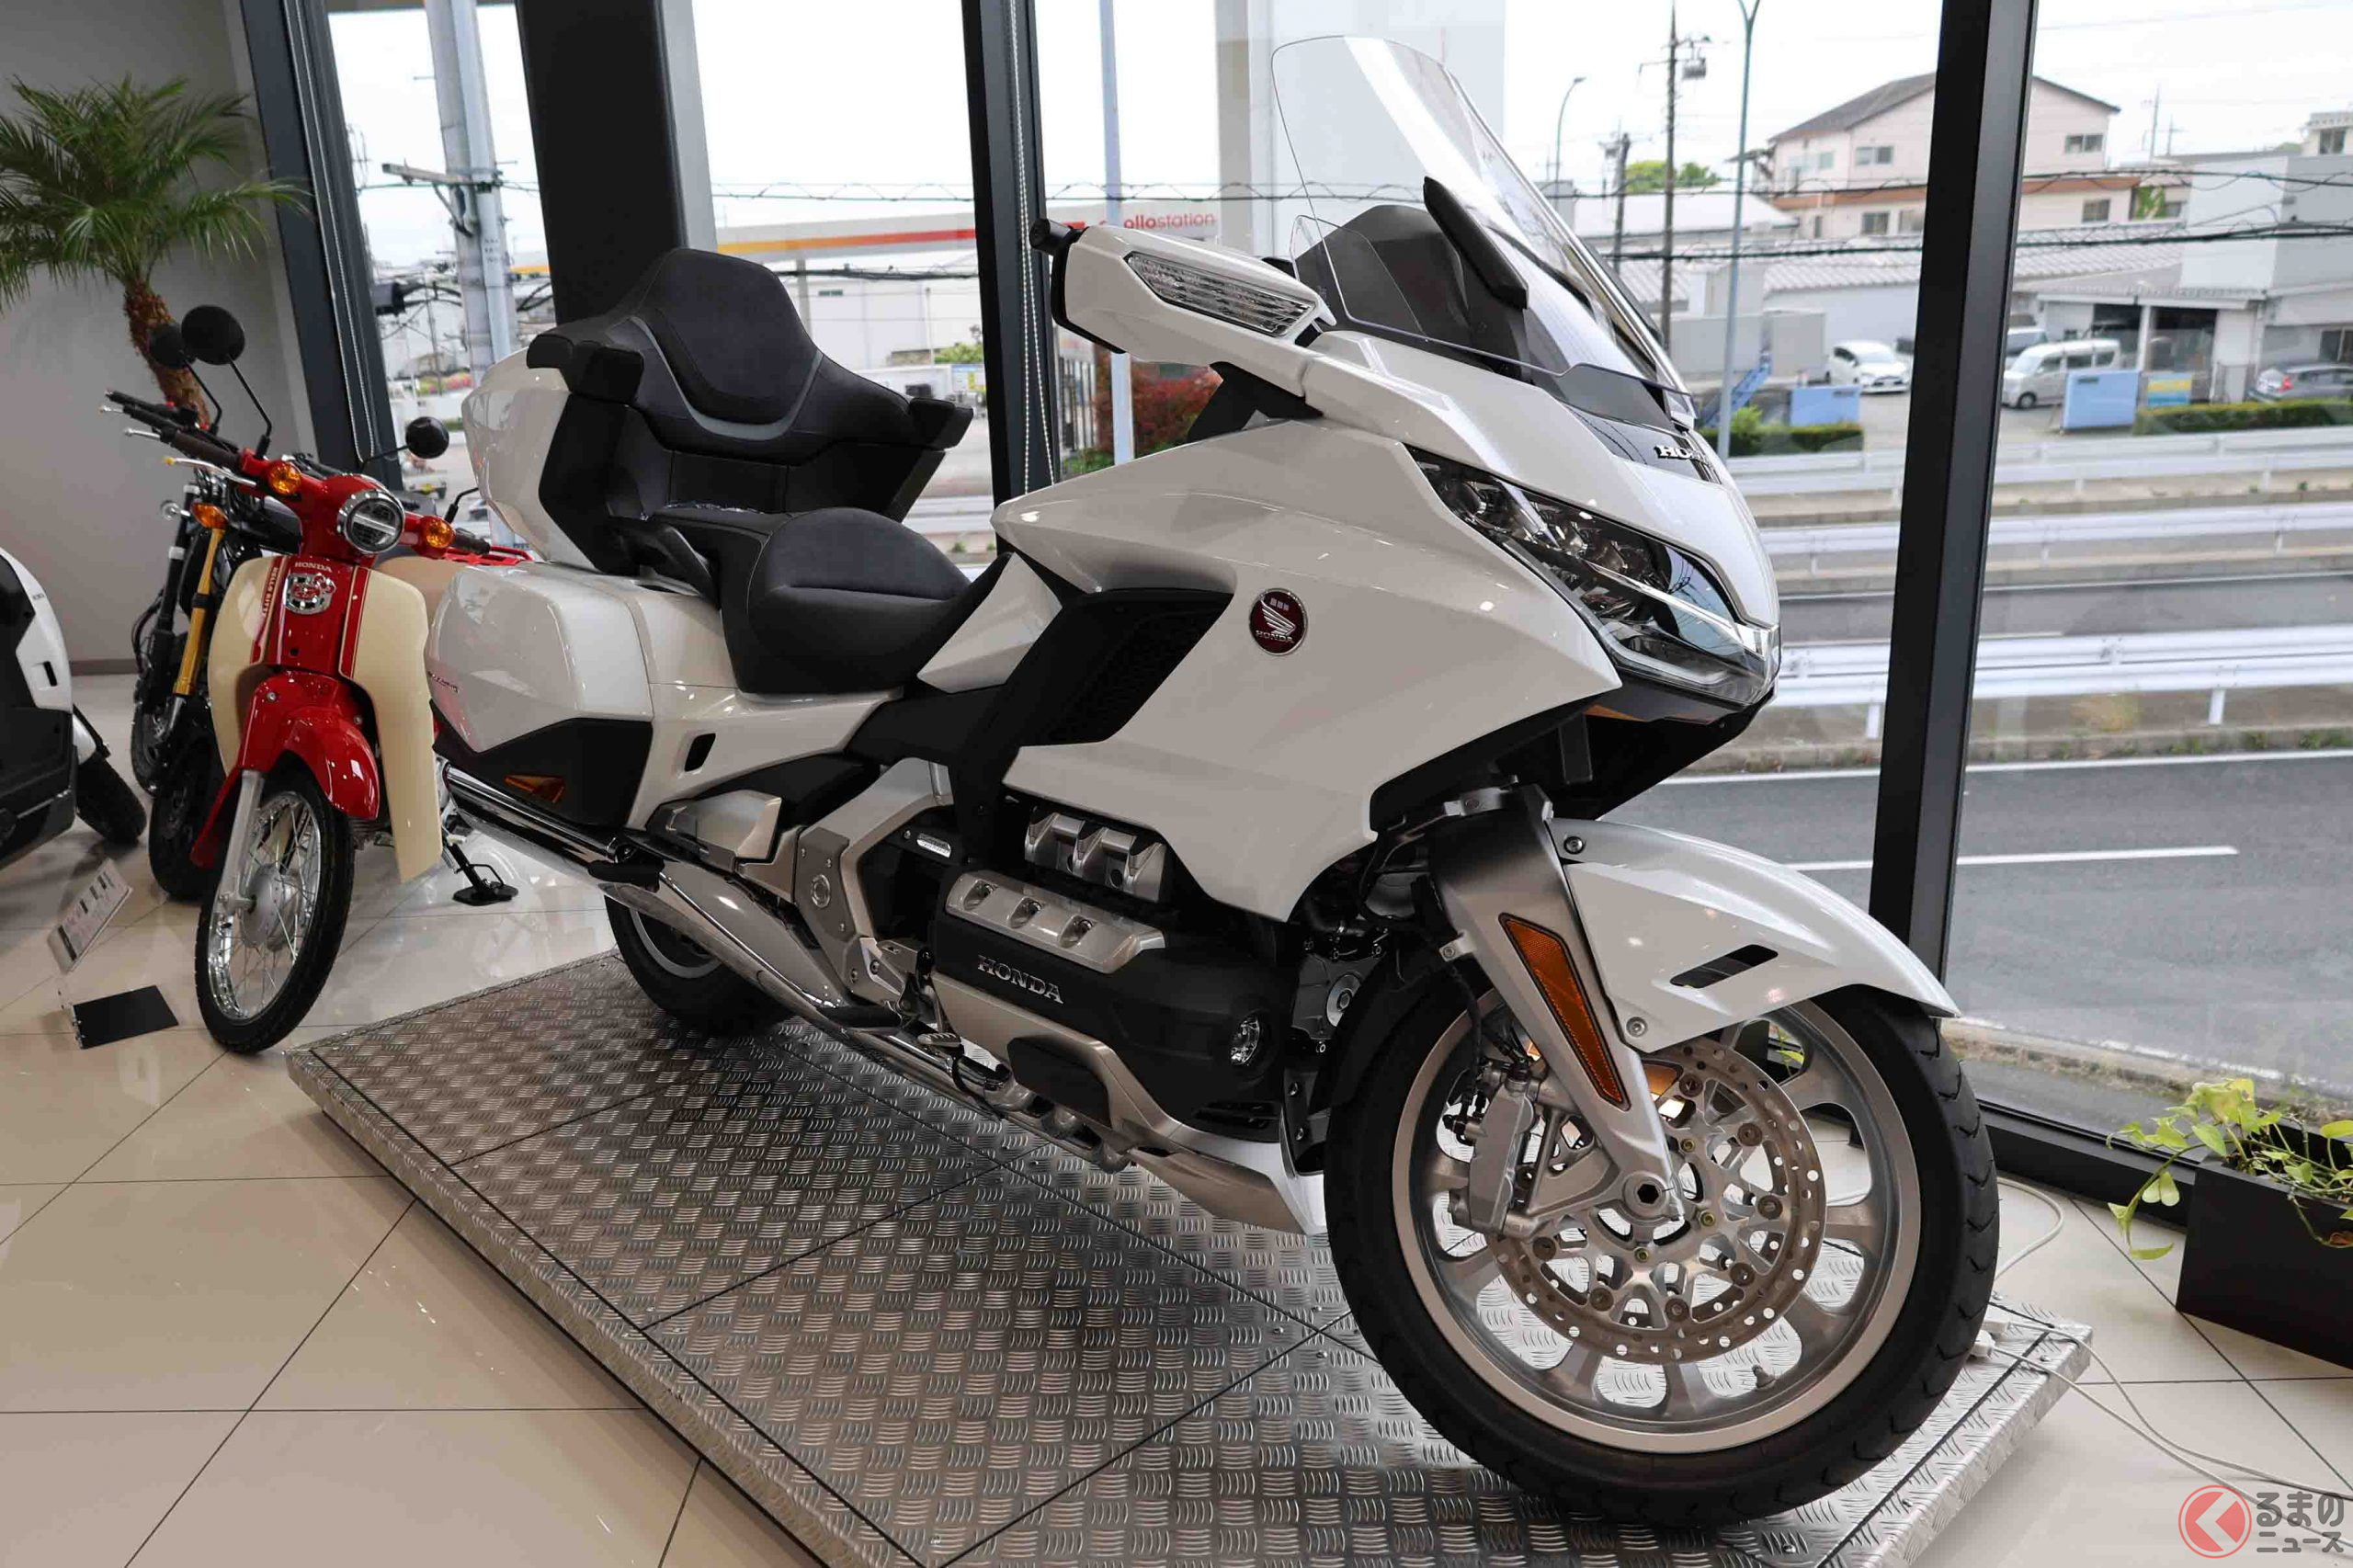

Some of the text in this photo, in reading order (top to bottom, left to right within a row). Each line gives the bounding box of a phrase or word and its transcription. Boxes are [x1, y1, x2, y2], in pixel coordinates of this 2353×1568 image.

[1100, 212, 1214, 230] ollostation
[294, 562, 333, 573] HONDA
[267, 566, 278, 592] HELLO
[1256, 630, 1294, 643] HONDA
[977, 955, 1064, 1005] HONDA
